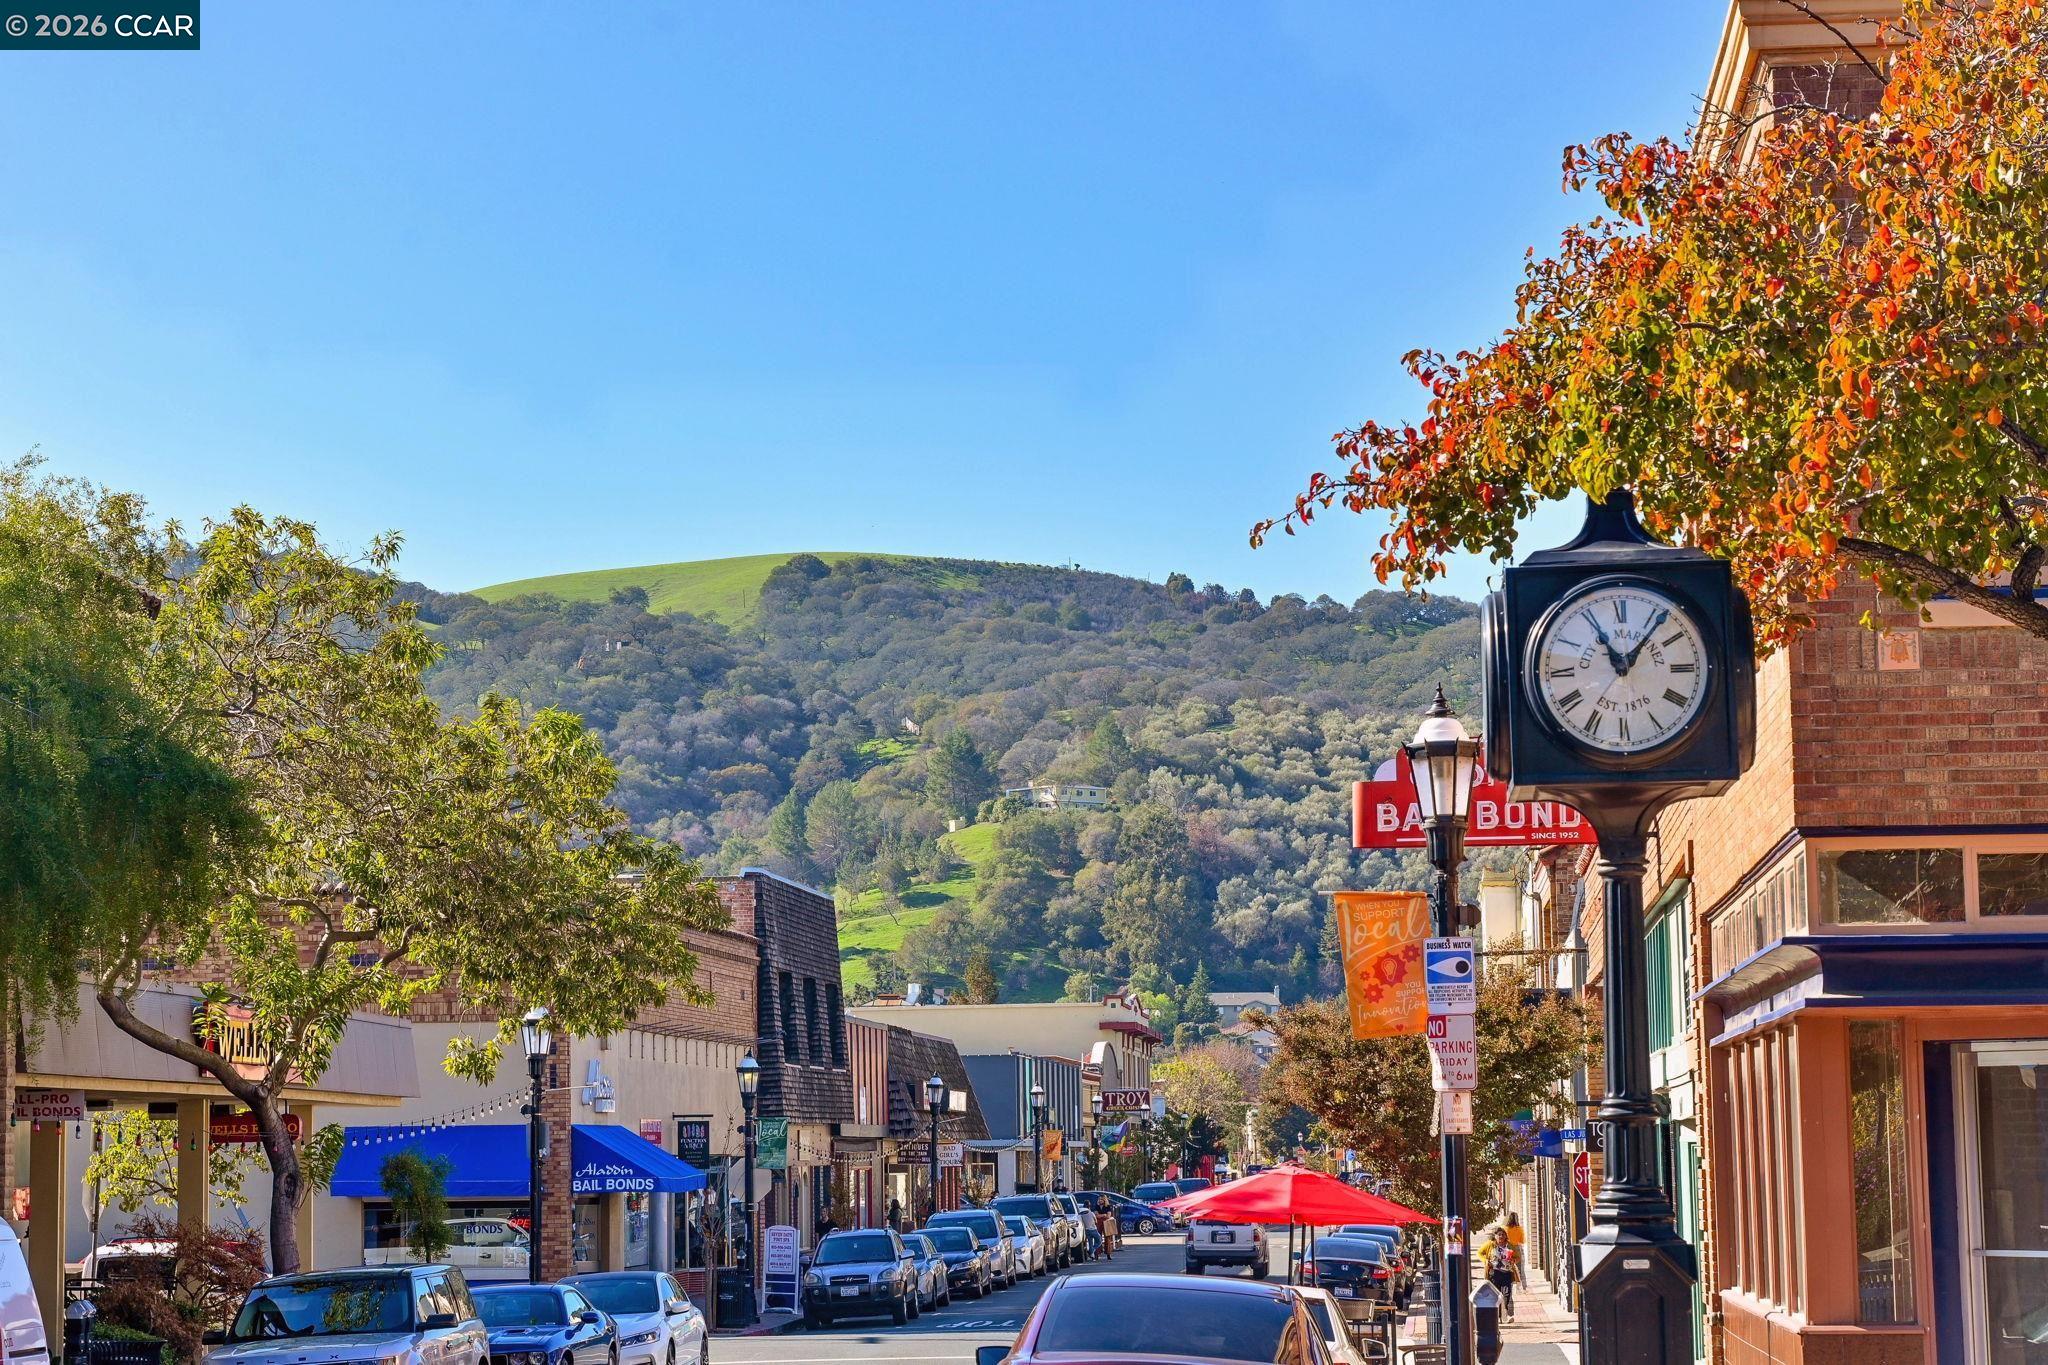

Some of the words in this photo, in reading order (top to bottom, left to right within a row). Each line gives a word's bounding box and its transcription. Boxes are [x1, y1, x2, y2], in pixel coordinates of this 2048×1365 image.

[1579, 642, 1597, 670] CITY
[1596, 695, 1621, 713] EST.
[1625, 694, 1651, 713] 1876
[1376, 802, 1424, 833] BA
[1476, 800, 1583, 831] BOND
[1530, 832, 1557, 840] SINCE
[1558, 831, 1580, 839] 1952
[1355, 901, 1380, 912] WHEN
[1381, 899, 1400, 908] YOU
[1353, 907, 1406, 922] SUPPORT
[1341, 897, 1426, 962] Local
[1426, 942, 1451, 950] BUSINESS
[1452, 941, 1472, 949] WATCH
[1404, 981, 1421, 989] YOU
[1396, 987, 1426, 998] SUPPO
[1428, 1020, 1444, 1037] NO
[1429, 1040, 1473, 1054] PARKING
[1438, 1057, 1468, 1067] RIDAY
[1456, 1070, 1473, 1081] 6AM
[1104, 1091, 1147, 1106] TROY
[32, 1106, 81, 1117] BONDS
[1564, 1131, 1576, 1139] LAS
[575, 1162, 634, 1178] Aladdin
[1575, 1166, 1590, 1185] ST
[572, 1179, 603, 1192] BAIL
[605, 1178, 655, 1191] BONDS
[465, 1224, 503, 1234] BONDS
[508, 1218, 531, 1229] OPE
